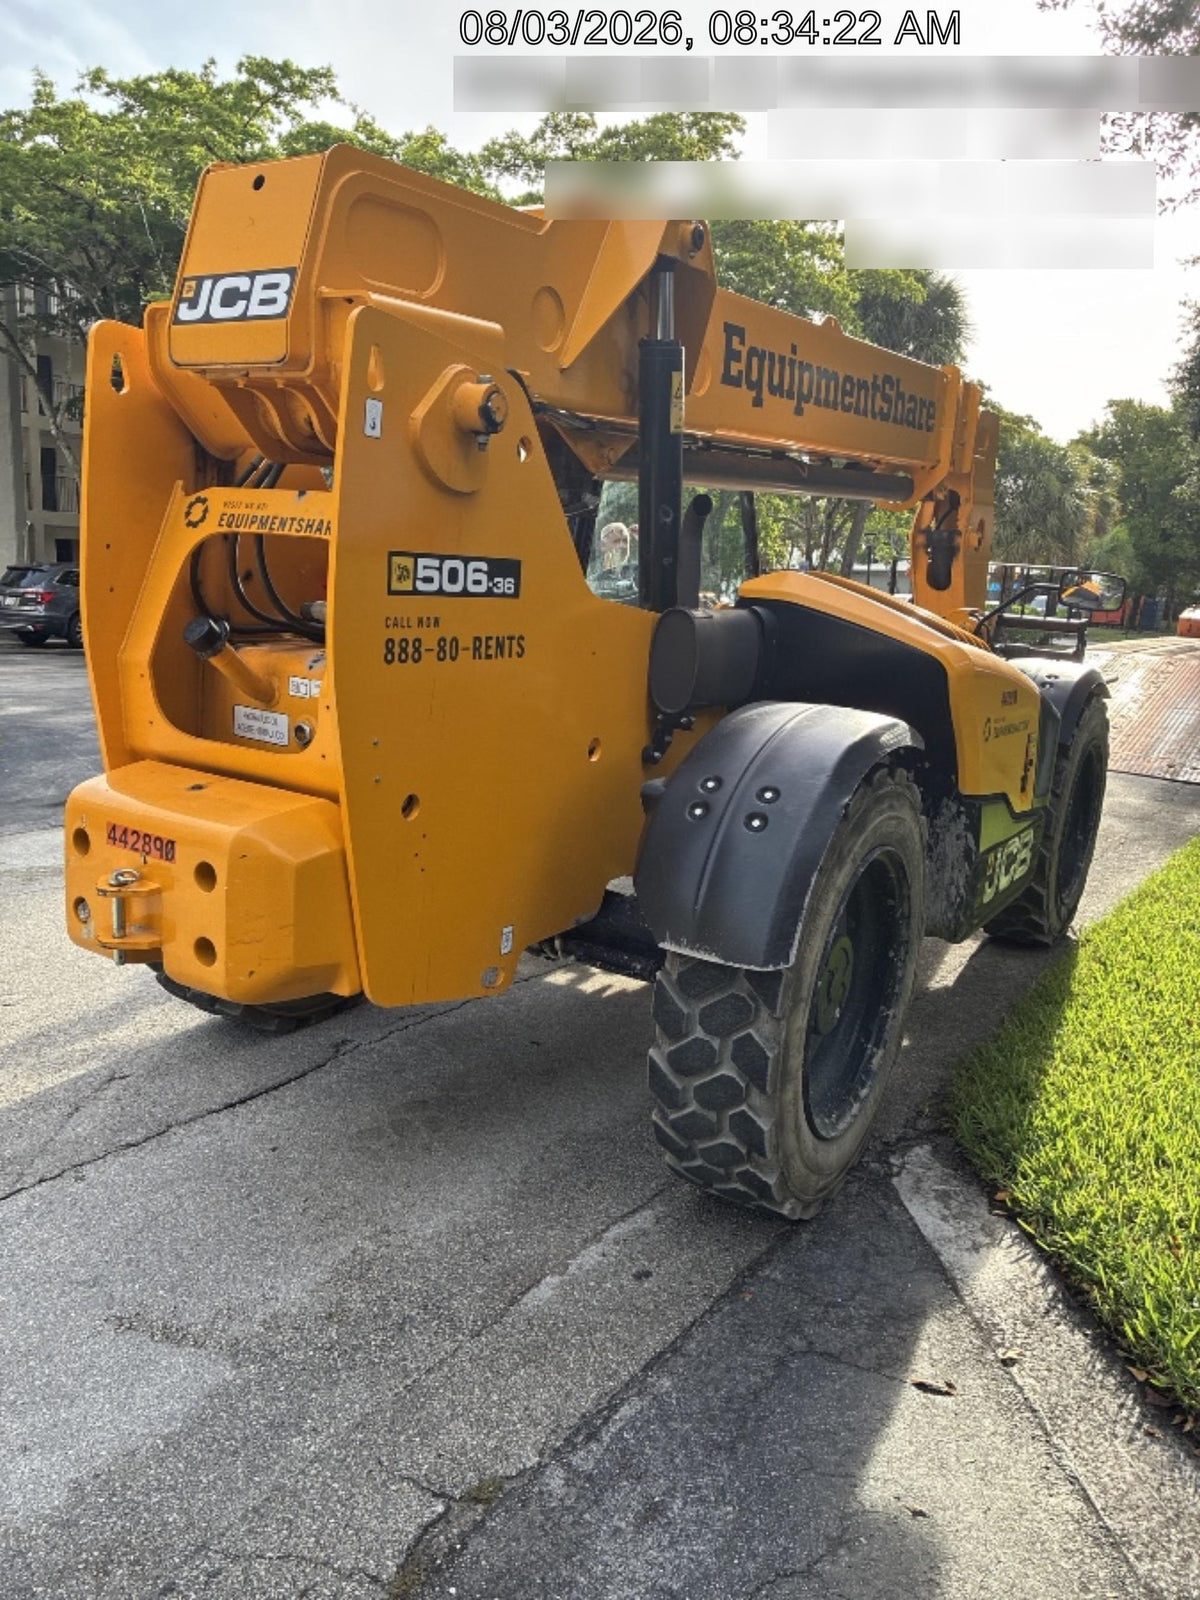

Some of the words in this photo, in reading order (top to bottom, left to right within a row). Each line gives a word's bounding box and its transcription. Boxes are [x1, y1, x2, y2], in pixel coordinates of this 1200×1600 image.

[177, 272, 291, 322] JCB
[720, 321, 937, 433] EquipmentShare
[385, 616, 412, 629] CALL
[417, 616, 441, 629] NOW
[384, 634, 526, 665] 888-80-RENTS
[107, 823, 176, 862] 442890
[982, 827, 1034, 905] JCB
